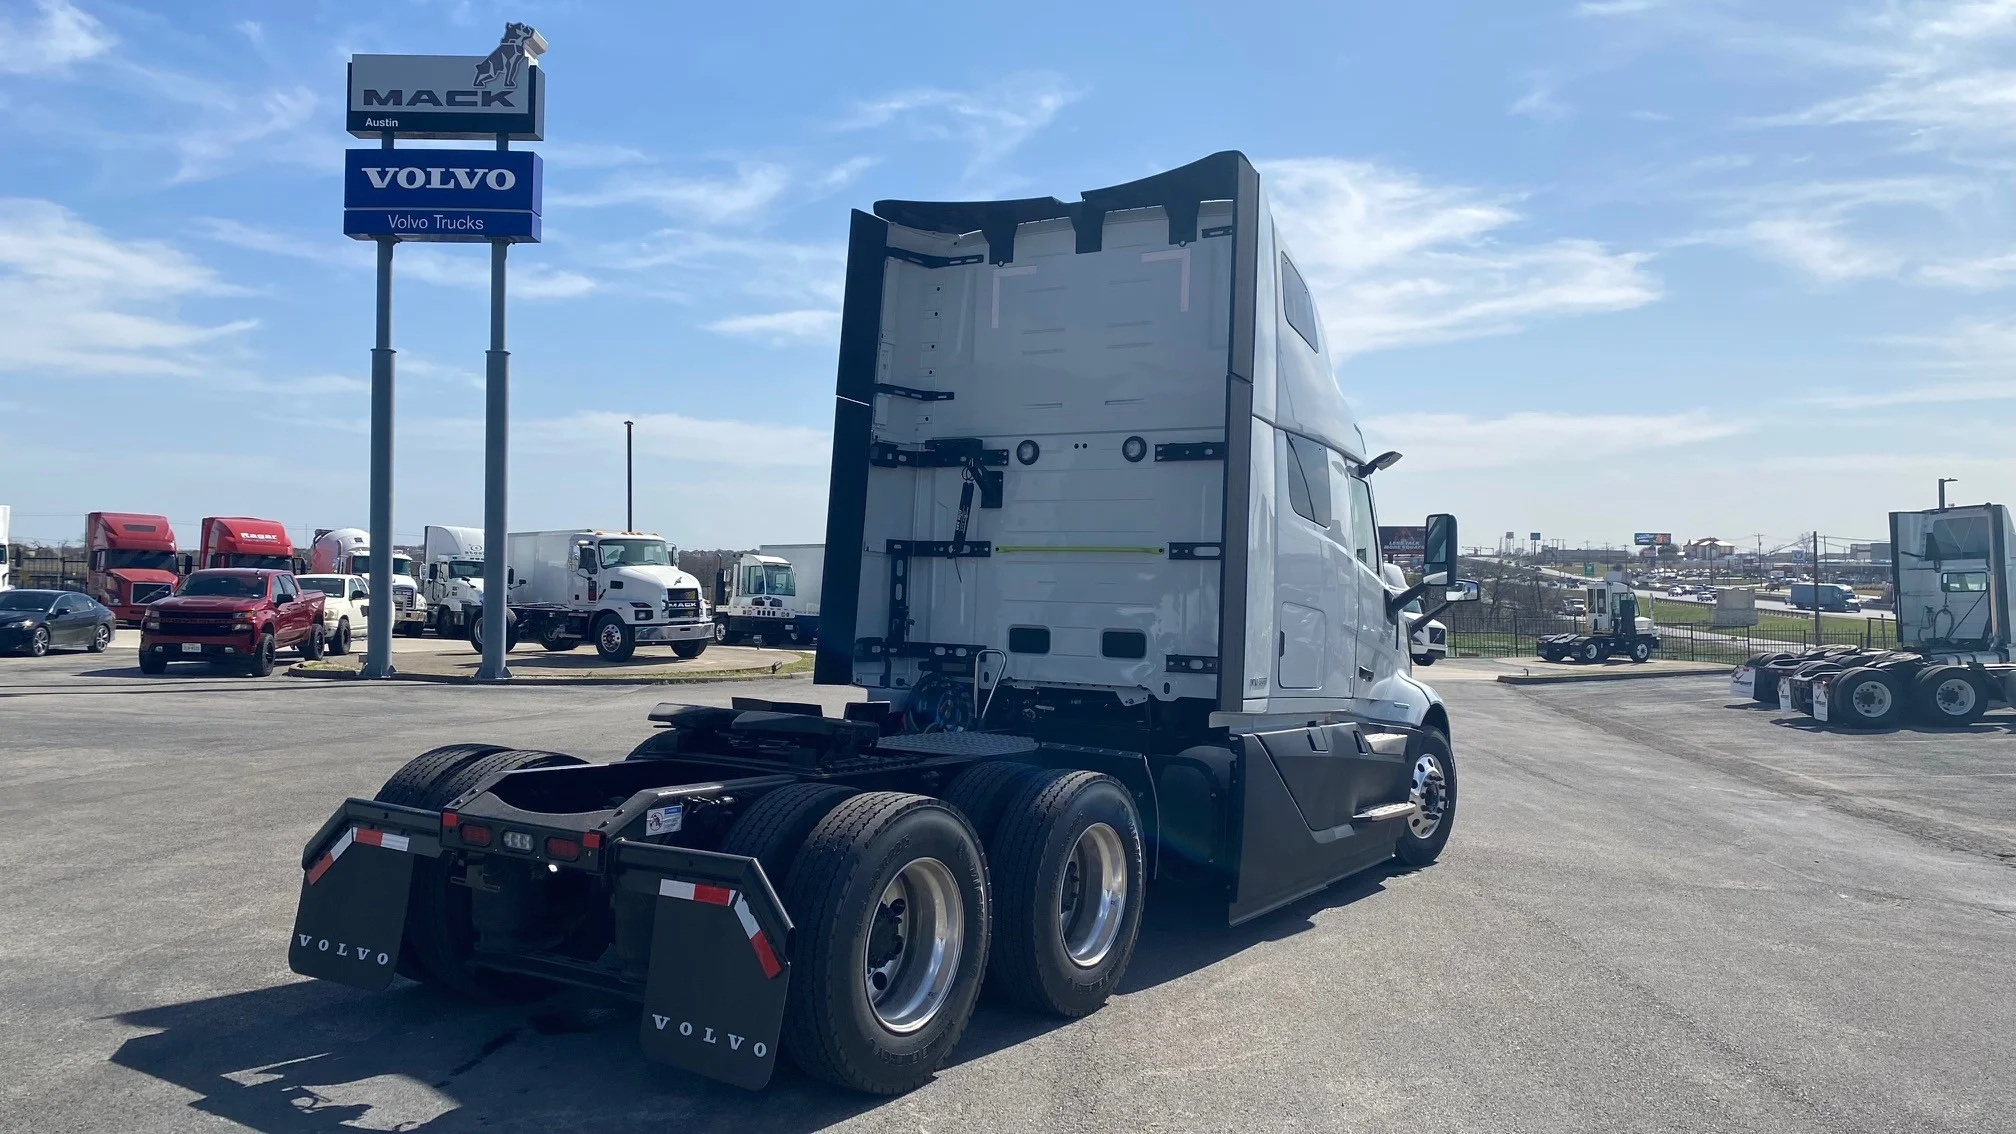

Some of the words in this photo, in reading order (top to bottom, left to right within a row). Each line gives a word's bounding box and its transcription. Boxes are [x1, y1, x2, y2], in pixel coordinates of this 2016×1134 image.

[363, 89, 515, 108] MACK
[365, 117, 399, 128] Austin
[361, 167, 516, 191] VOLVO
[388, 214, 428, 230] Volvo
[433, 215, 484, 230] Trucks
[298, 933, 389, 965] VOLVO
[652, 1013, 767, 1058] VOLVO
